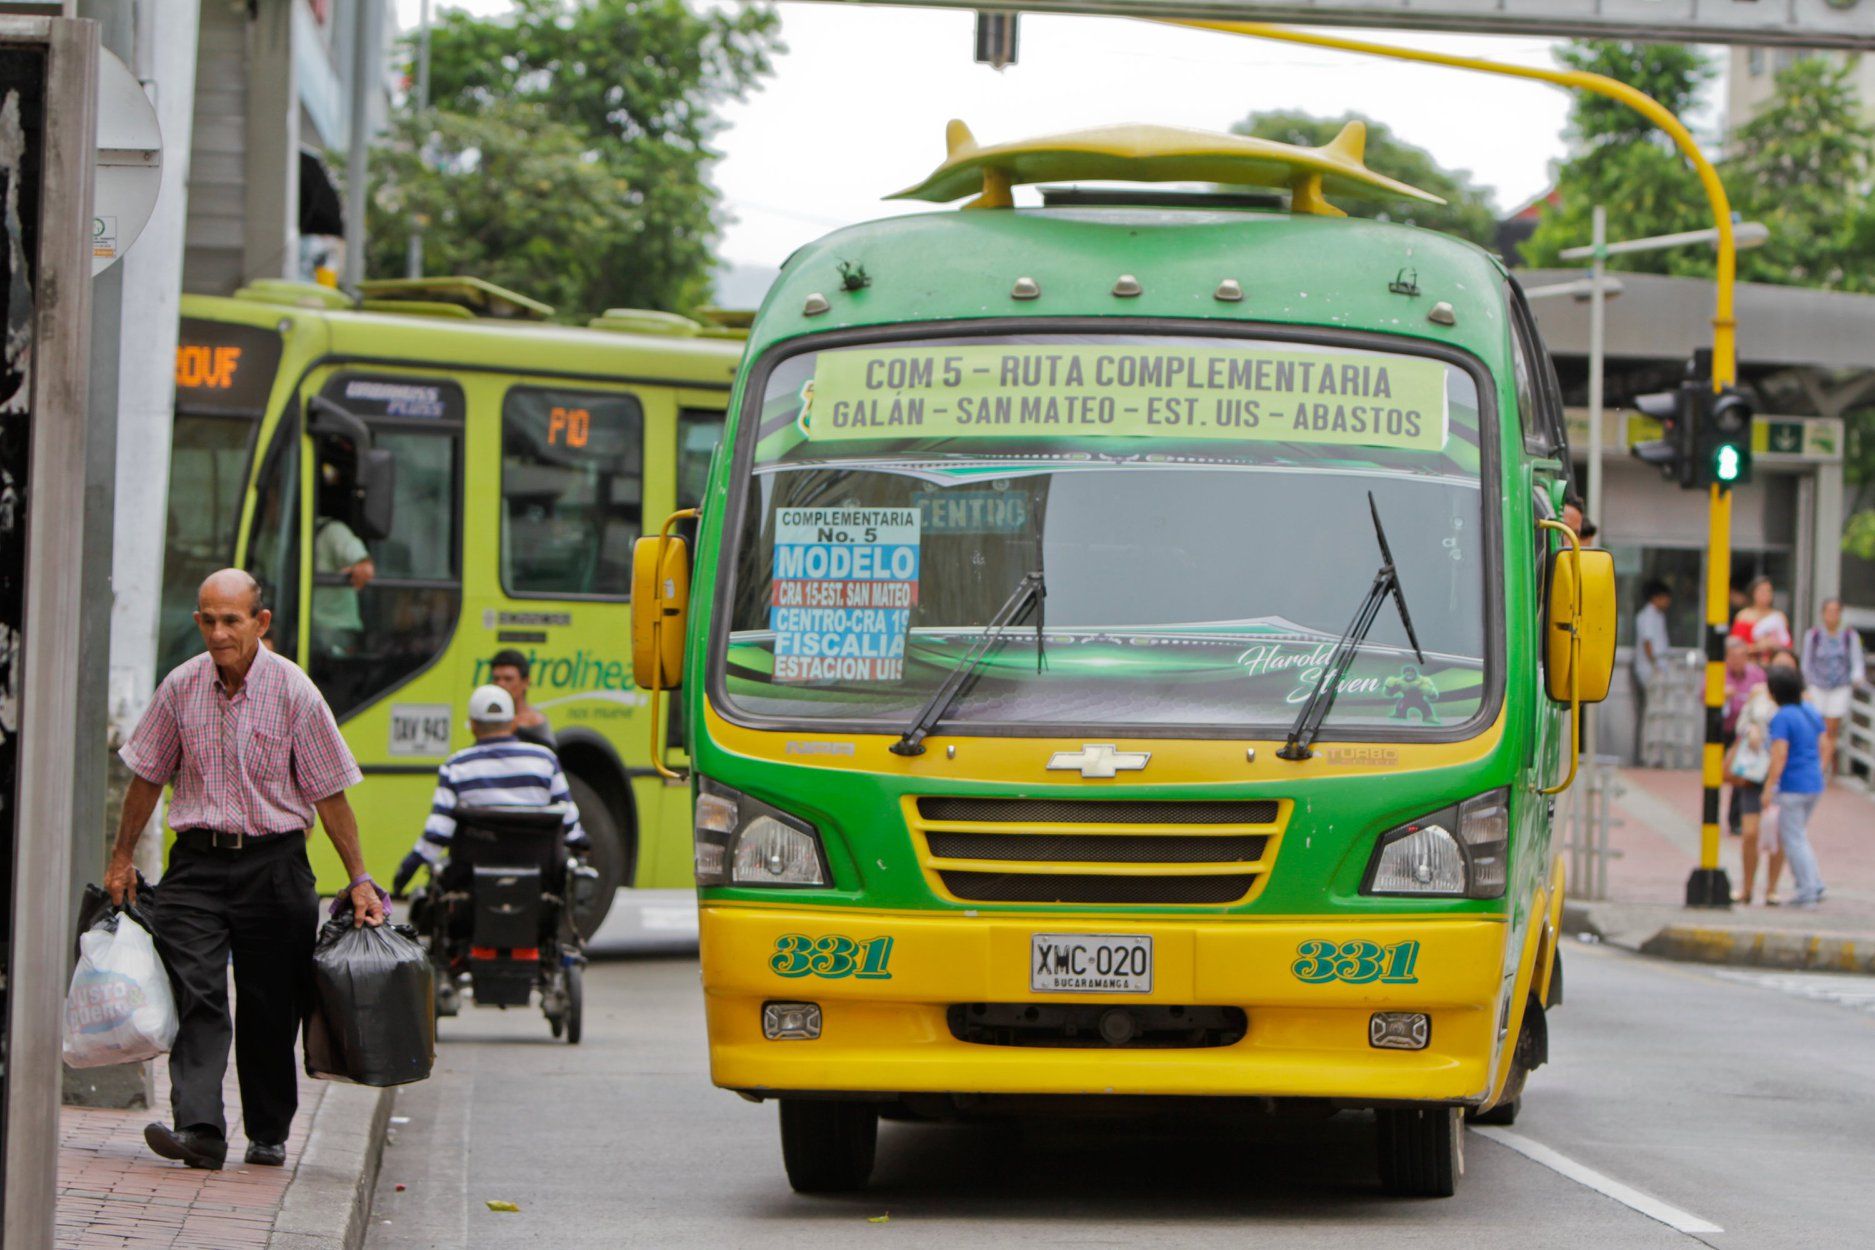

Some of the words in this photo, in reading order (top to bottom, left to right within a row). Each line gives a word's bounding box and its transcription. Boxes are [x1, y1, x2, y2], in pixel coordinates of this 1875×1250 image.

[865, 356, 935, 390] COM
[942, 356, 964, 388] 5
[1000, 354, 1085, 388] RUTA
[1094, 355, 1392, 400] COMPLEMENTARIA
[831, 391, 925, 428] GALÁN
[956, 396, 1012, 425] SAN
[1019, 396, 1116, 424] MATEO
[1146, 396, 1208, 427] EST.
[1215, 398, 1261, 428] UIS
[1292, 402, 1422, 438] ABASTOS
[781, 511, 915, 527] COMPLEMENTARIA
[817, 527, 855, 543] No.
[864, 527, 878, 543] 5
[777, 545, 916, 580] MODELO
[778, 581, 803, 606] CRA
[846, 581, 870, 607] SAN
[872, 582, 911, 608] MATEO
[776, 608, 887, 633] CENTRO-CRA
[774, 632, 906, 658] FISCALIA
[1237, 643, 1339, 676] Harold
[774, 656, 871, 680] ESTACION
[769, 933, 894, 979] 331
[1037, 943, 1087, 976] XMC
[1096, 945, 1147, 977] 020
[1291, 939, 1420, 984] 331
[1054, 977, 1129, 989] BUCARAMANGA
